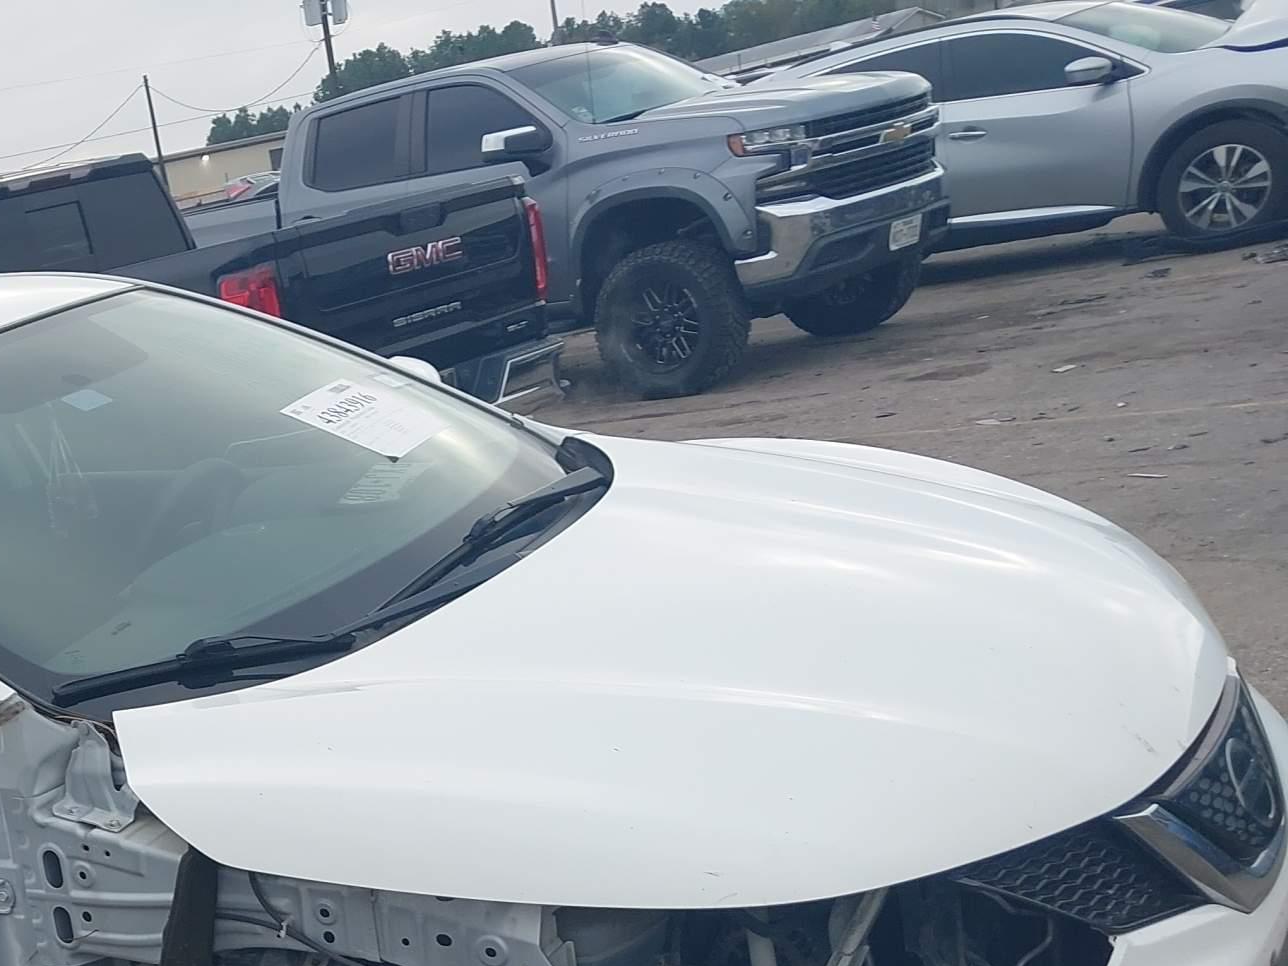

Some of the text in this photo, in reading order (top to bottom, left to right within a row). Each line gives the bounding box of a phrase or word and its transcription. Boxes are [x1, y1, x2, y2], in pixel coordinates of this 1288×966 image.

[386, 236, 463, 276] GMC
[392, 301, 462, 328] SIERRA
[316, 391, 377, 424] 43843916
